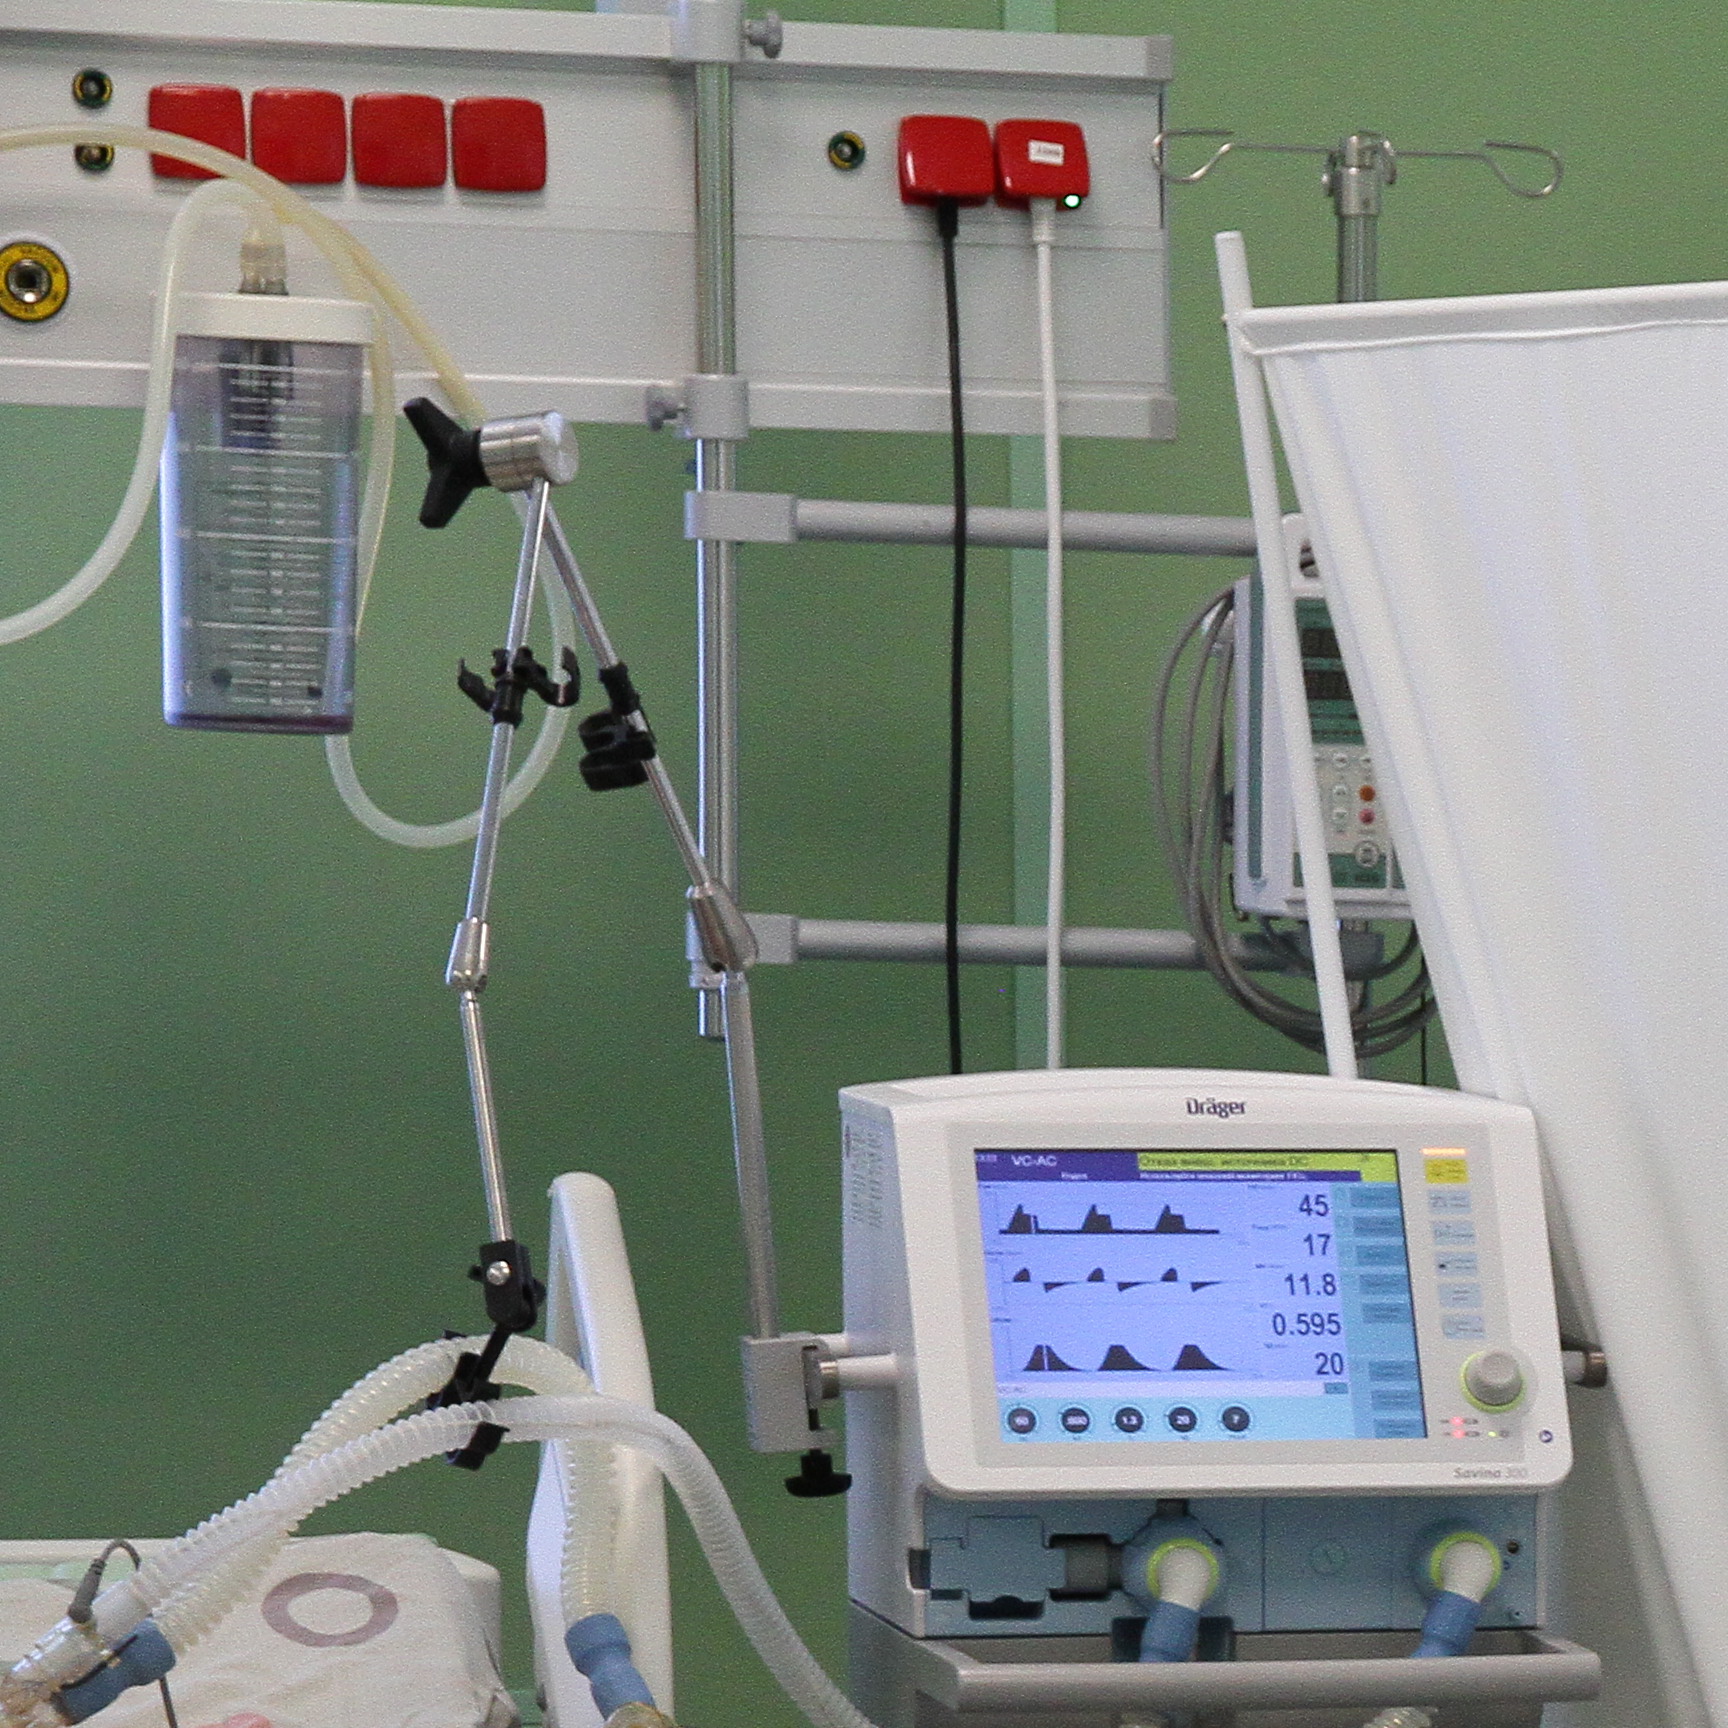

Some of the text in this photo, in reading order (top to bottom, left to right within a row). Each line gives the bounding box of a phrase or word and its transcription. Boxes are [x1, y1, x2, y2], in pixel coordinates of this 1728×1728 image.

[1186, 1097, 1247, 1118] Dräger
[1299, 1194, 1329, 1217] 45
[1303, 1233, 1331, 1256] 17
[1285, 1273, 1337, 1296] 11.8
[1272, 1312, 1342, 1336] 0.595
[1315, 1352, 1344, 1376] 20
